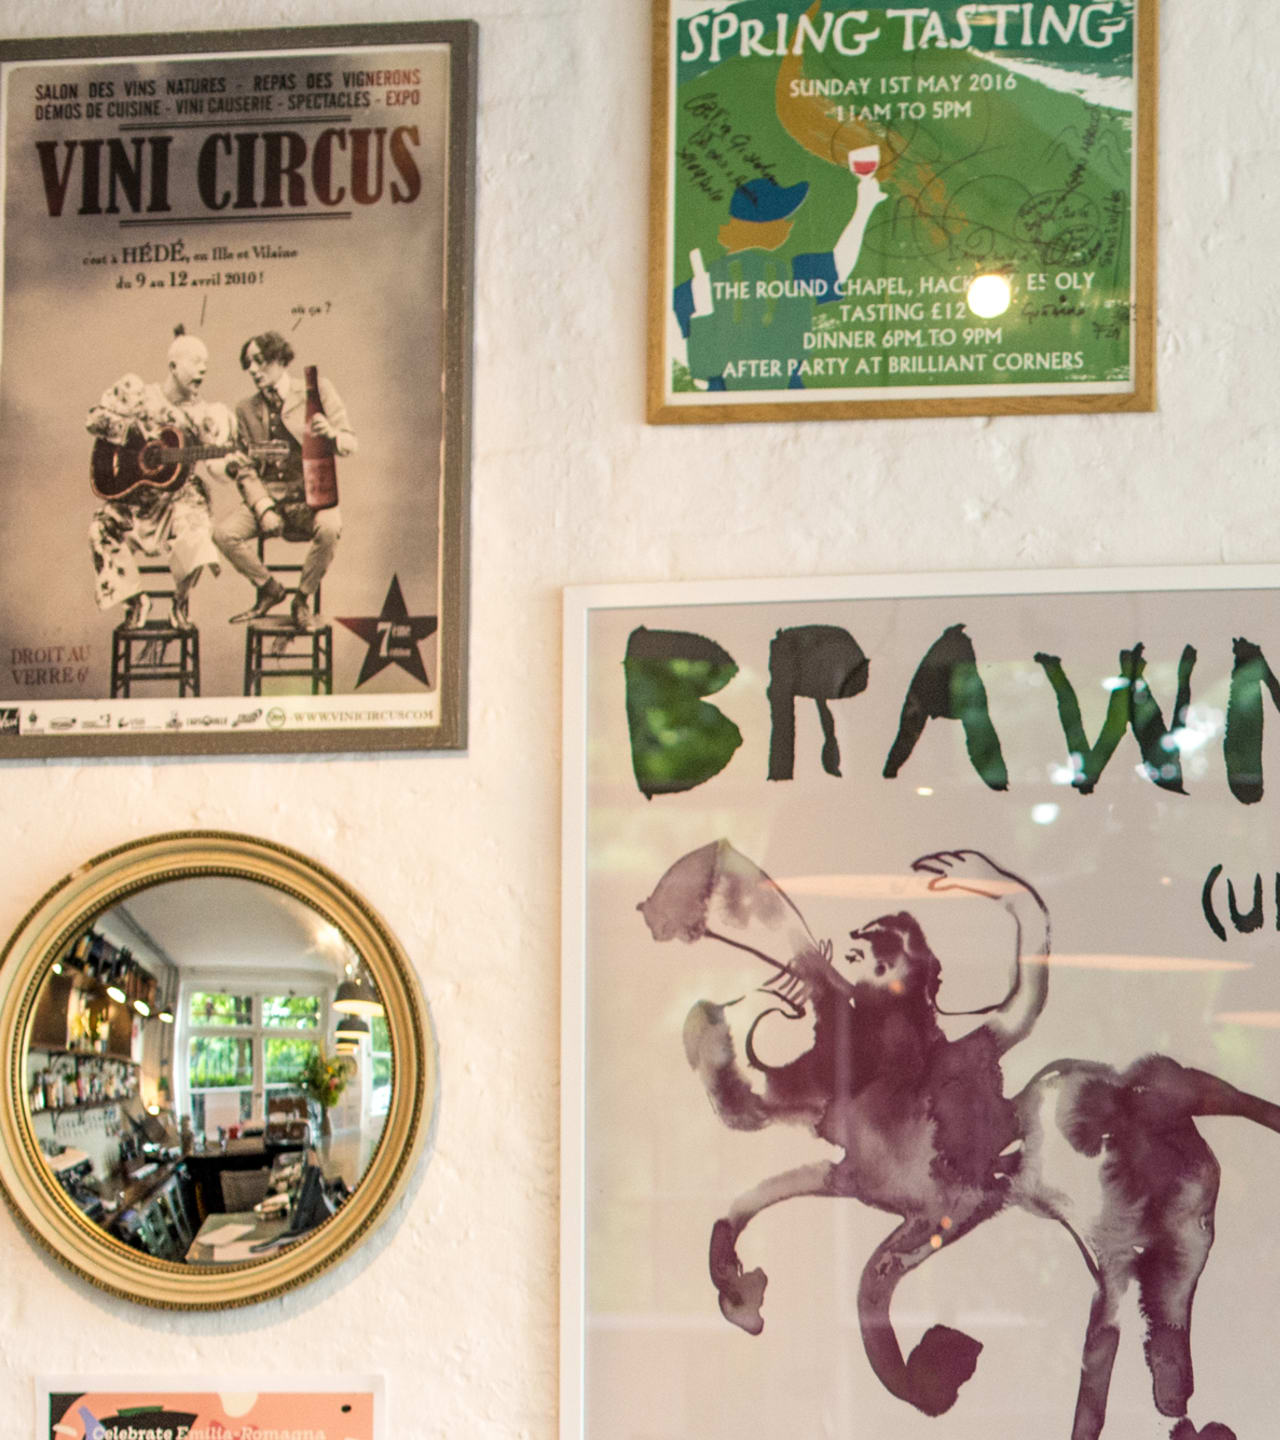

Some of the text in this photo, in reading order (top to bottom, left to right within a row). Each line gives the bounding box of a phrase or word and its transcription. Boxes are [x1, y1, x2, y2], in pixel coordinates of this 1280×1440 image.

[680, 2, 1128, 62] SPRING TASTING
[35, 68, 421, 100] SALON DES VINS NATURES REPAS DES VIGNERONS
[790, 73, 1017, 97] SUNDAY 1ST MAY 2016
[35, 88, 420, 121] DÉMOS DE CUISINE VINI CAUSERIE SPECTACLES EXPO
[836, 101, 972, 123] 11AM TO 5PM
[35, 124, 422, 217] VINI CIRCUS
[122, 239, 190, 265] HÉDÉ,
[252, 245, 298, 259] Vilaine
[116, 276, 132, 289] du
[136, 272, 146, 288] 9
[150, 279, 165, 288] au
[170, 271, 188, 287] 12
[191, 272, 221, 287] avril
[713, 281, 753, 301] THE
[755, 278, 828, 300] ROUND
[833, 277, 914, 299] CHAPEL,
[840, 302, 967, 323] TASTING £12
[803, 327, 1003, 350] DINNER 6PM TO 9PM
[722, 351, 1085, 379] AFTER PARTY AT BRILLIANT CORNERS
[376, 621, 393, 657] 7
[11, 644, 92, 665] DROIT AU
[11, 666, 73, 686] VERRE
